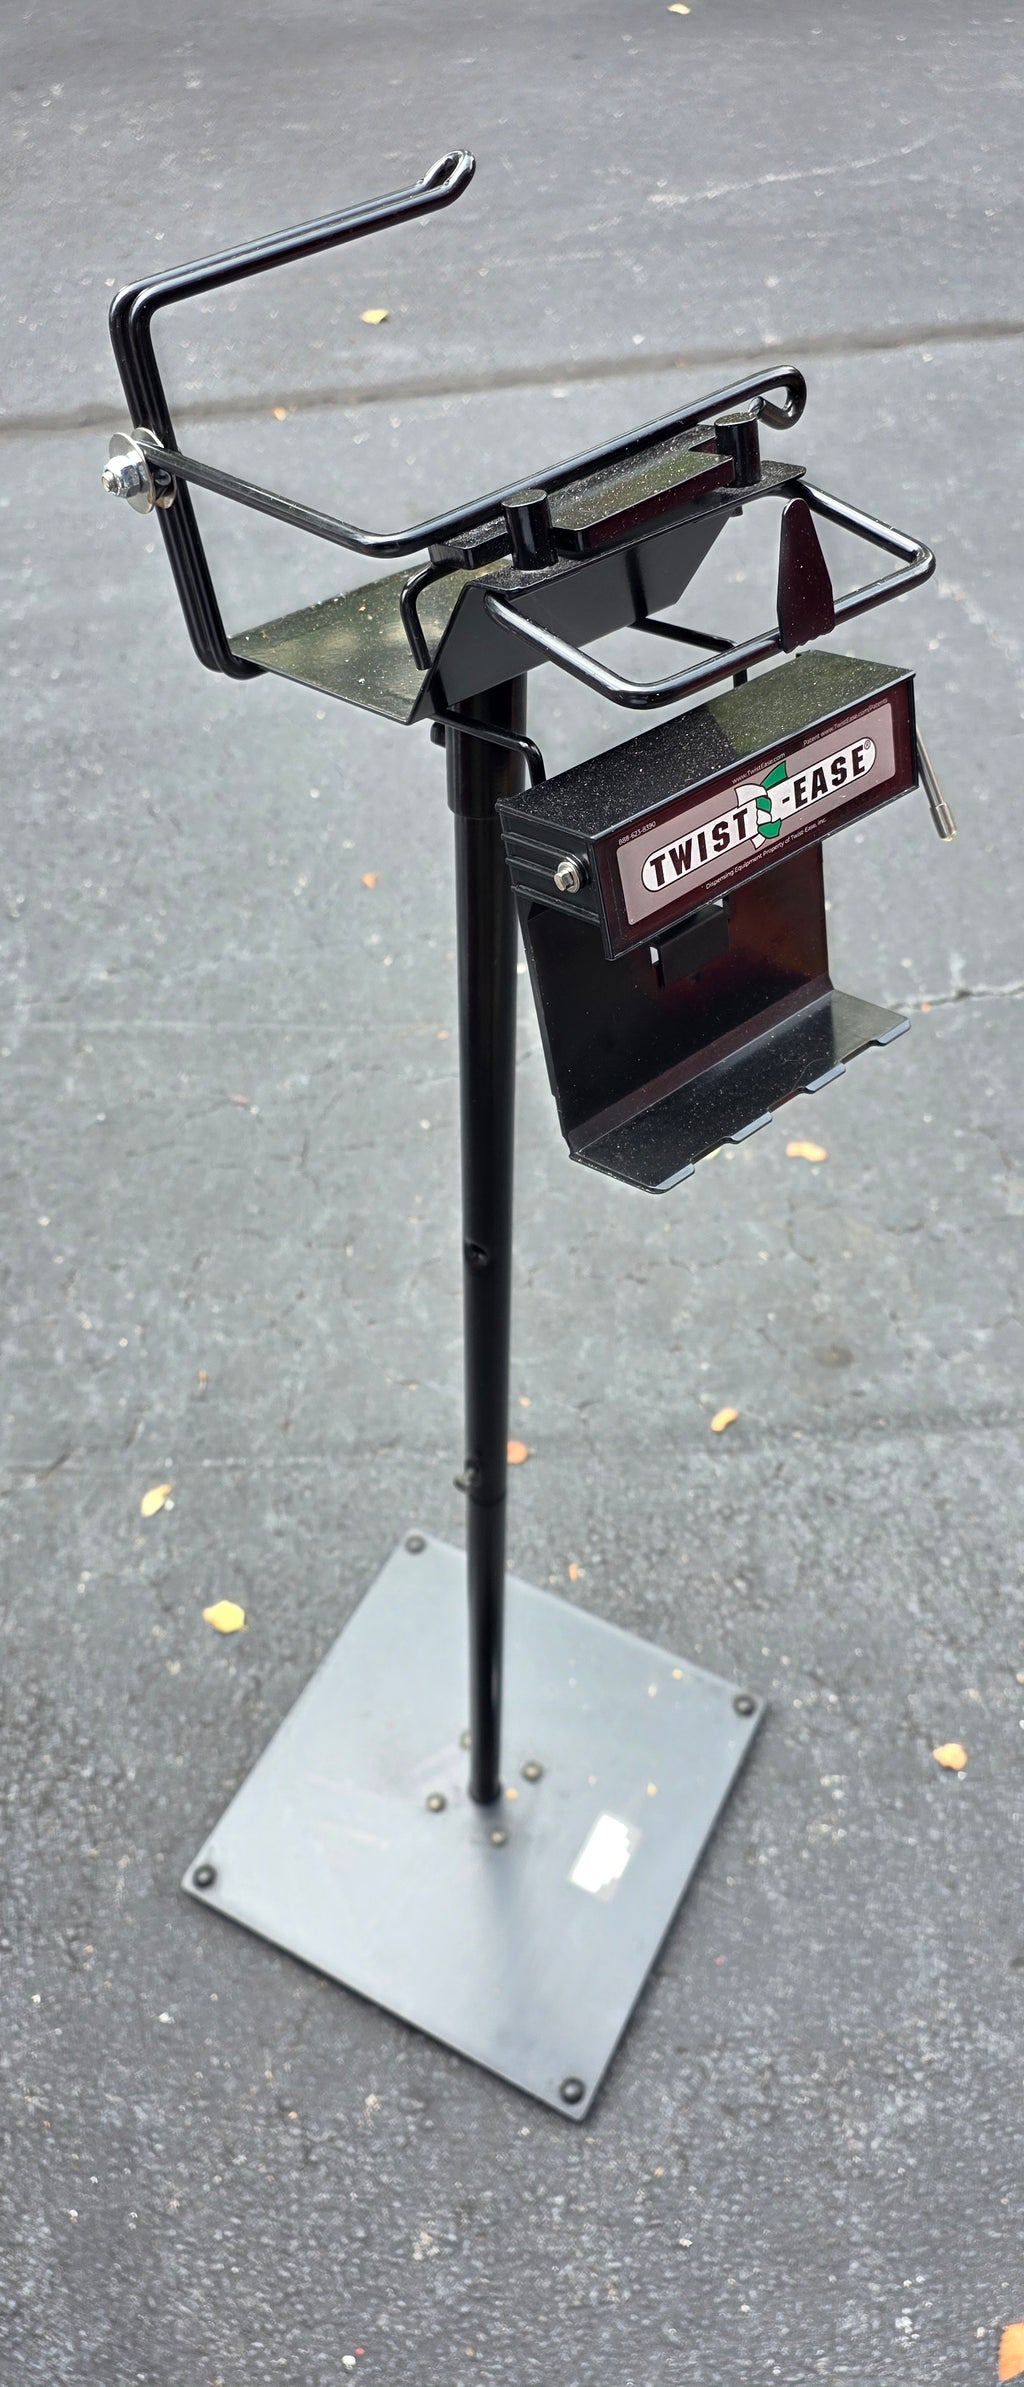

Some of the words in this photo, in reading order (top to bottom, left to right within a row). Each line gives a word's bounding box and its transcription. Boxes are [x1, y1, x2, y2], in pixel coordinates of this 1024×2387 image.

[803, 732, 820, 747] Patent
[731, 752, 786, 784] www.TwistEase.com
[705, 868, 734, 889] Dispensing
[734, 853, 762, 873] Equipment
[763, 840, 784, 856] Property
[784, 834, 792, 844] of
